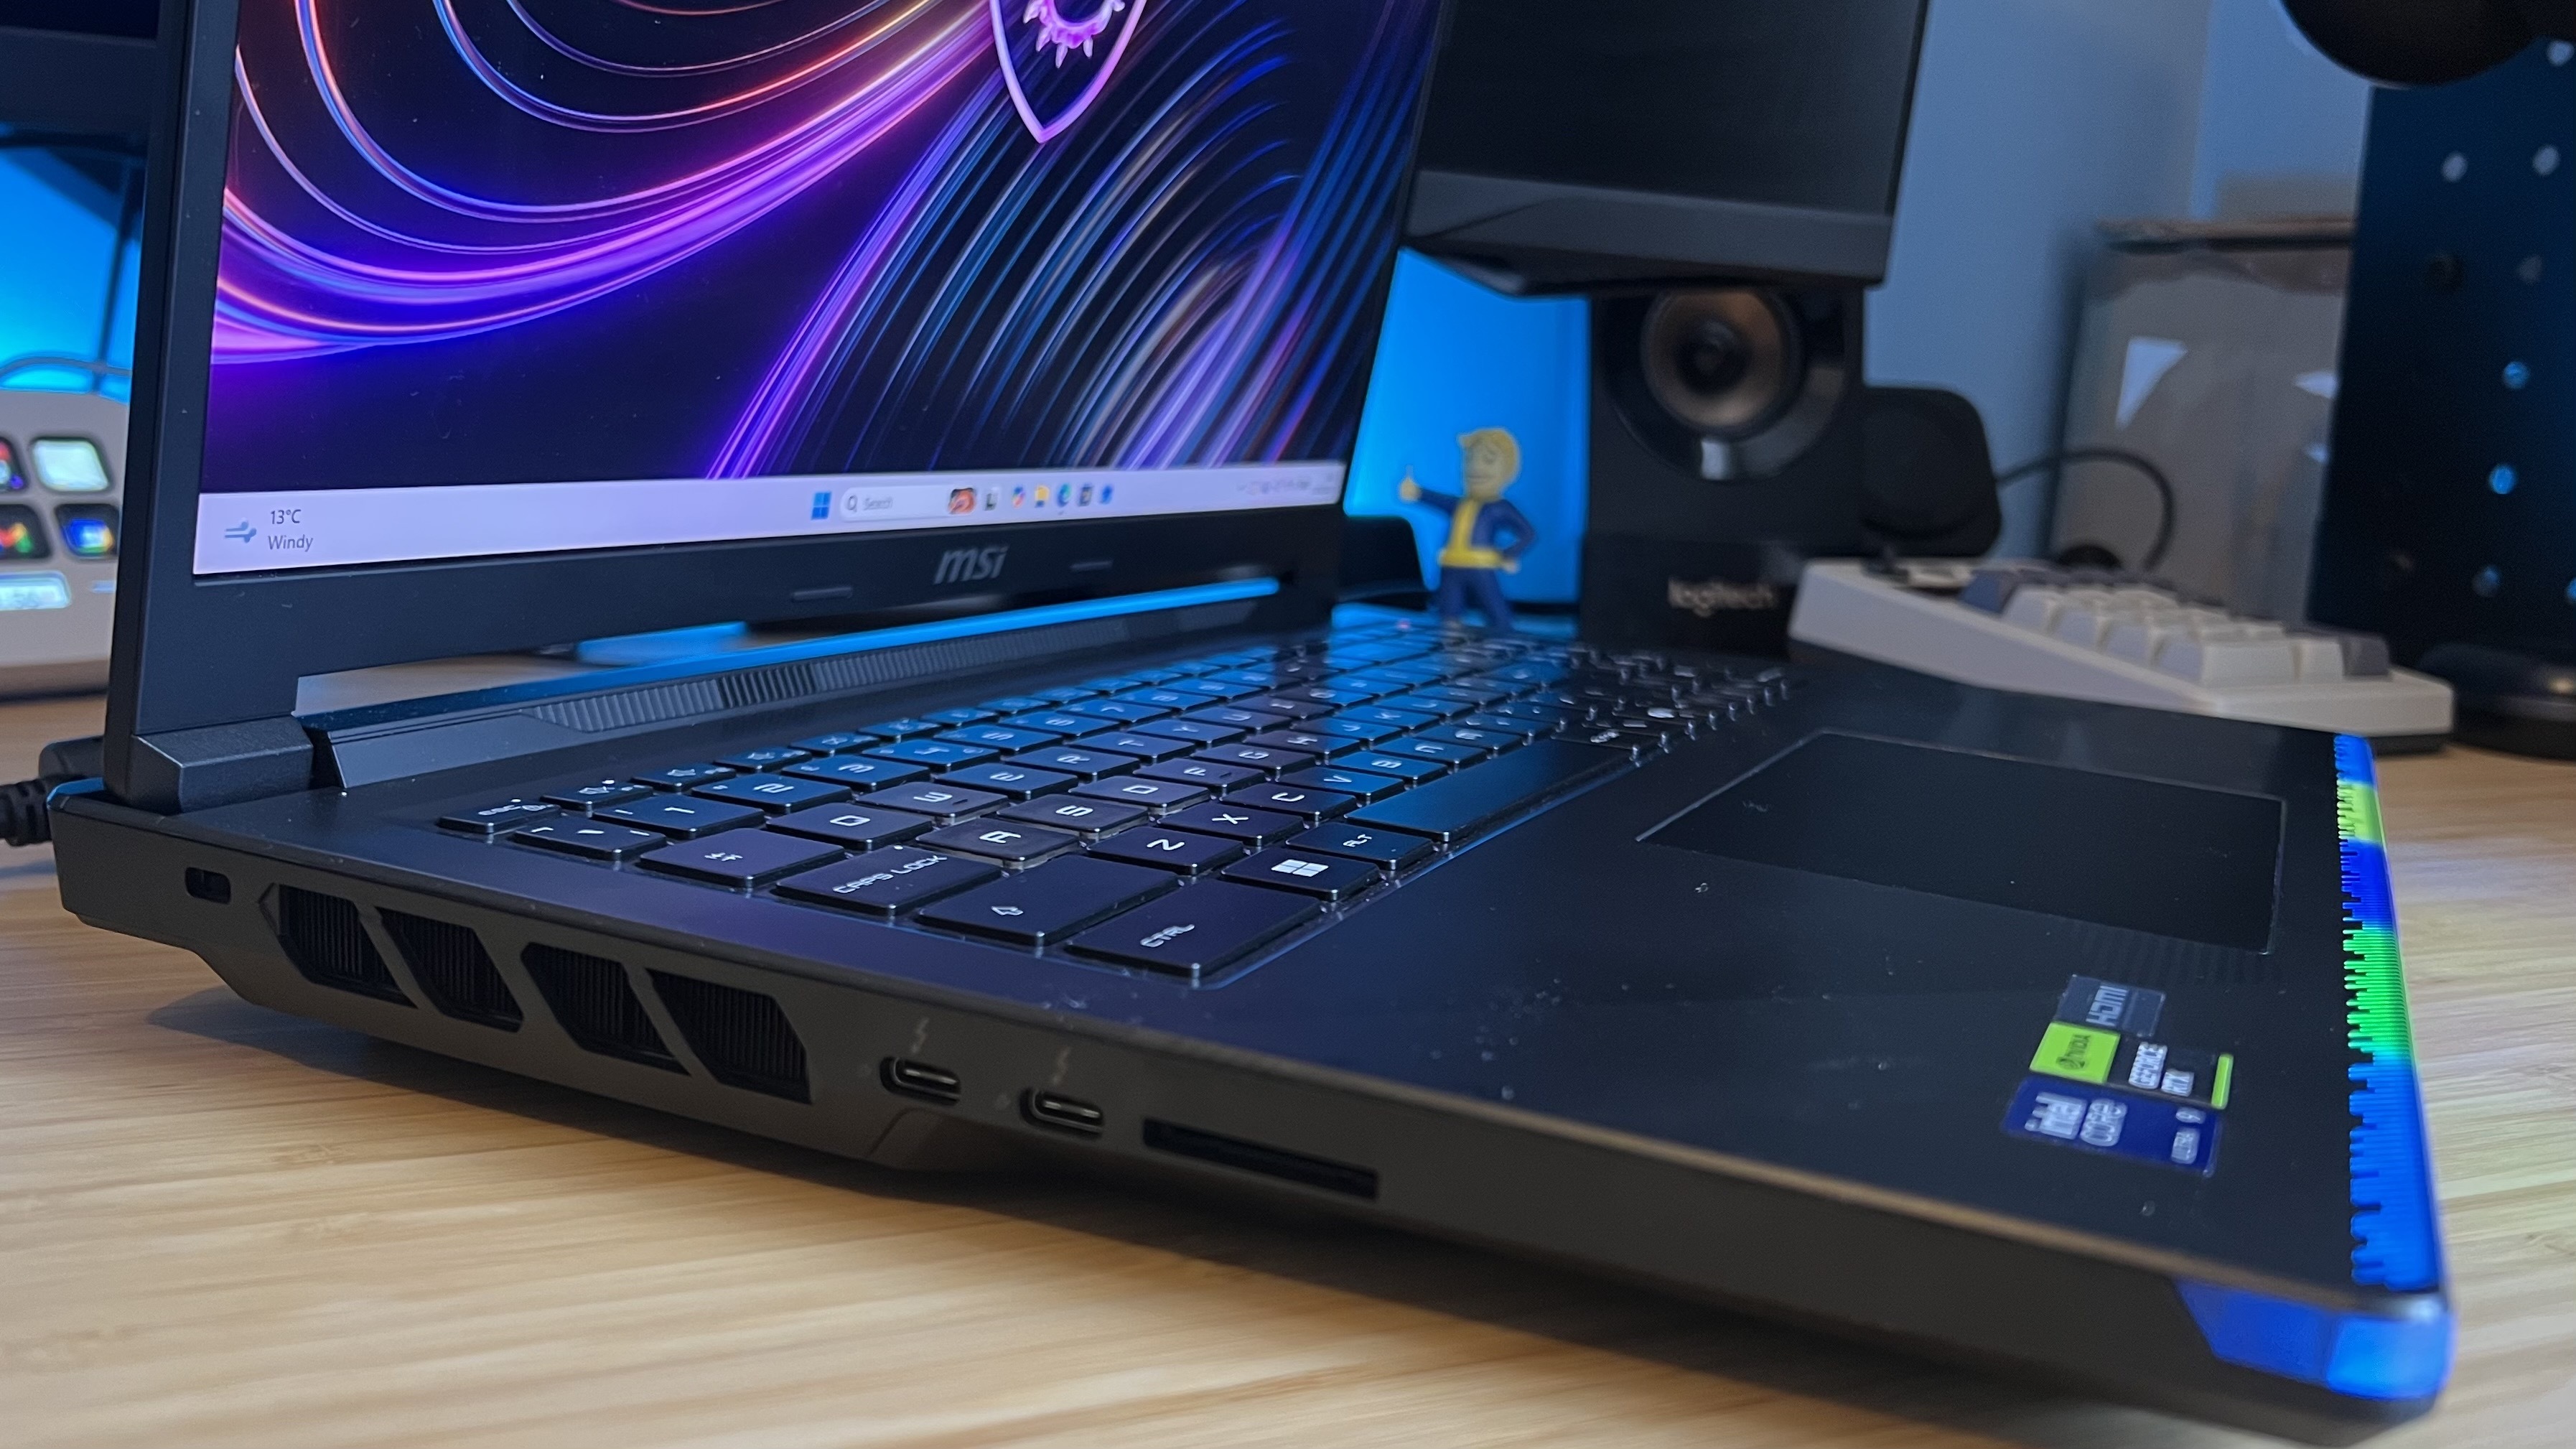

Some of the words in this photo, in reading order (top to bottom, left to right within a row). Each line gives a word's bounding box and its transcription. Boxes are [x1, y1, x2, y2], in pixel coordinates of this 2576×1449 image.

[270, 508, 302, 525] 13°C
[268, 534, 314, 552] Windy
[1271, 792, 1305, 803] C
[1211, 812, 1249, 825] X
[1147, 838, 1185, 852] Z
[832, 872, 895, 894] CAPS
[890, 854, 948, 875] LOCK
[1140, 923, 1195, 949] CTRL
